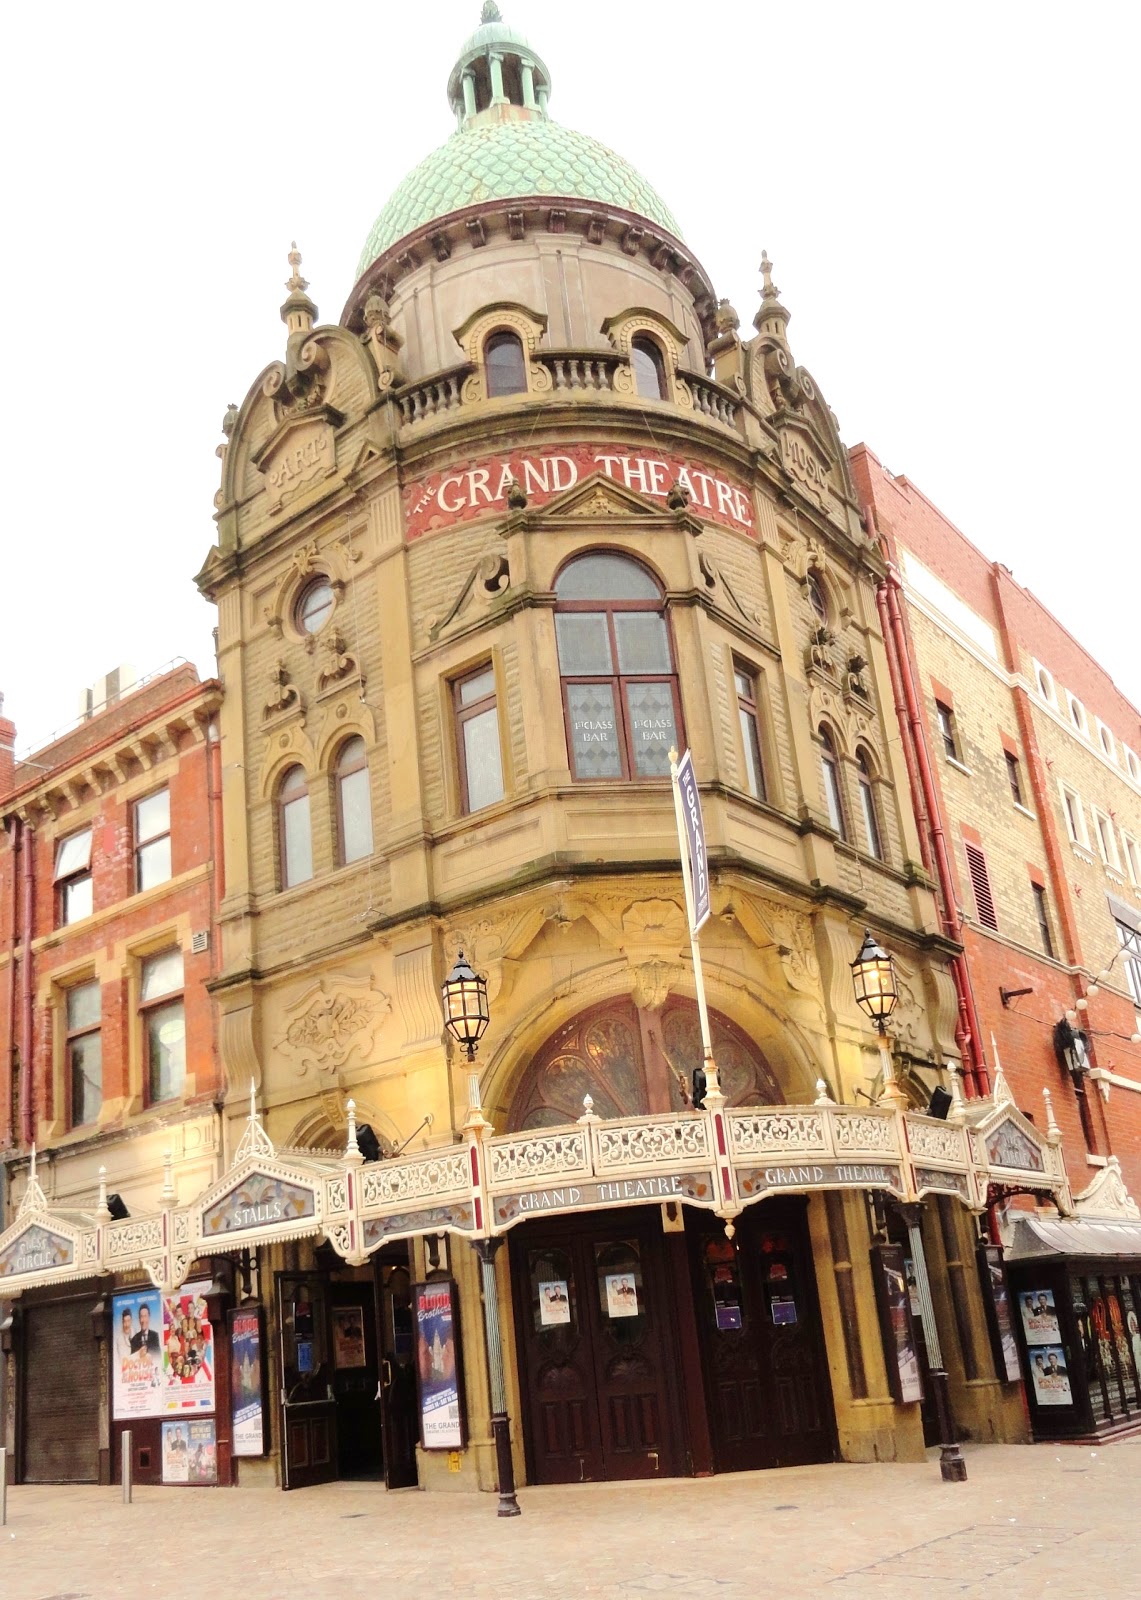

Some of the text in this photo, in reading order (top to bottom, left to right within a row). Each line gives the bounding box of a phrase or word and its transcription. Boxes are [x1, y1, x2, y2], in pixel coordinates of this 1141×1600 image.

[275, 439, 321, 488] ART
[782, 431, 829, 488] MUSIC
[413, 455, 752, 527] THE GRAND THEATRE
[584, 721, 613, 730] CLASS
[644, 719, 672, 729] CLASS
[583, 733, 608, 742] BAR
[642, 731, 667, 741] BAR
[686, 785, 706, 897] GRAND
[764, 1165, 890, 1184] GRAND THEATRE
[519, 1176, 683, 1210] GRAND THEATRE
[234, 1202, 281, 1226] STALLS
[17, 1251, 51, 1269] CIRCLE
[419, 1293, 450, 1310] BLOOD
[438, 1421, 460, 1429] GRAND
